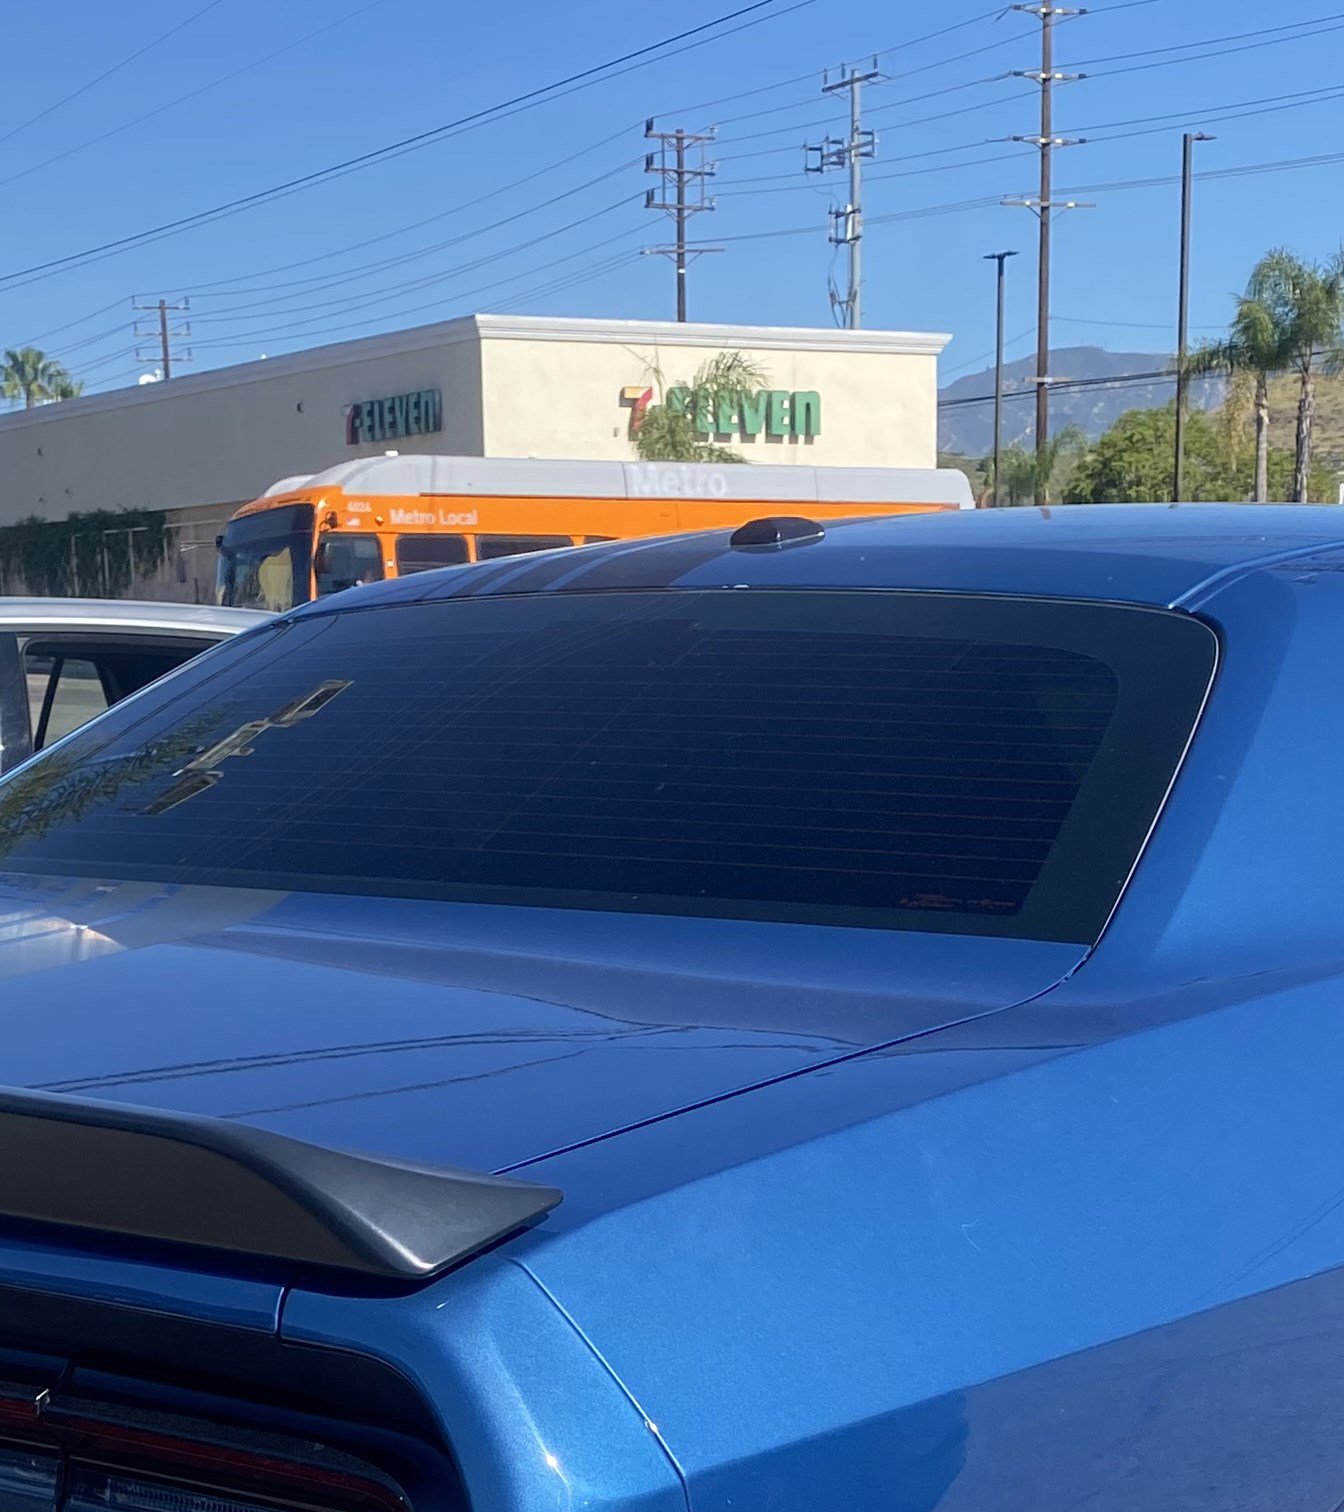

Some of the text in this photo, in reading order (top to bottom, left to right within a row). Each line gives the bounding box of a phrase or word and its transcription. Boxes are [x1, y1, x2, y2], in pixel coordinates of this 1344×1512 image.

[630, 464, 727, 497] Metro
[389, 508, 478, 526] Metro Local
